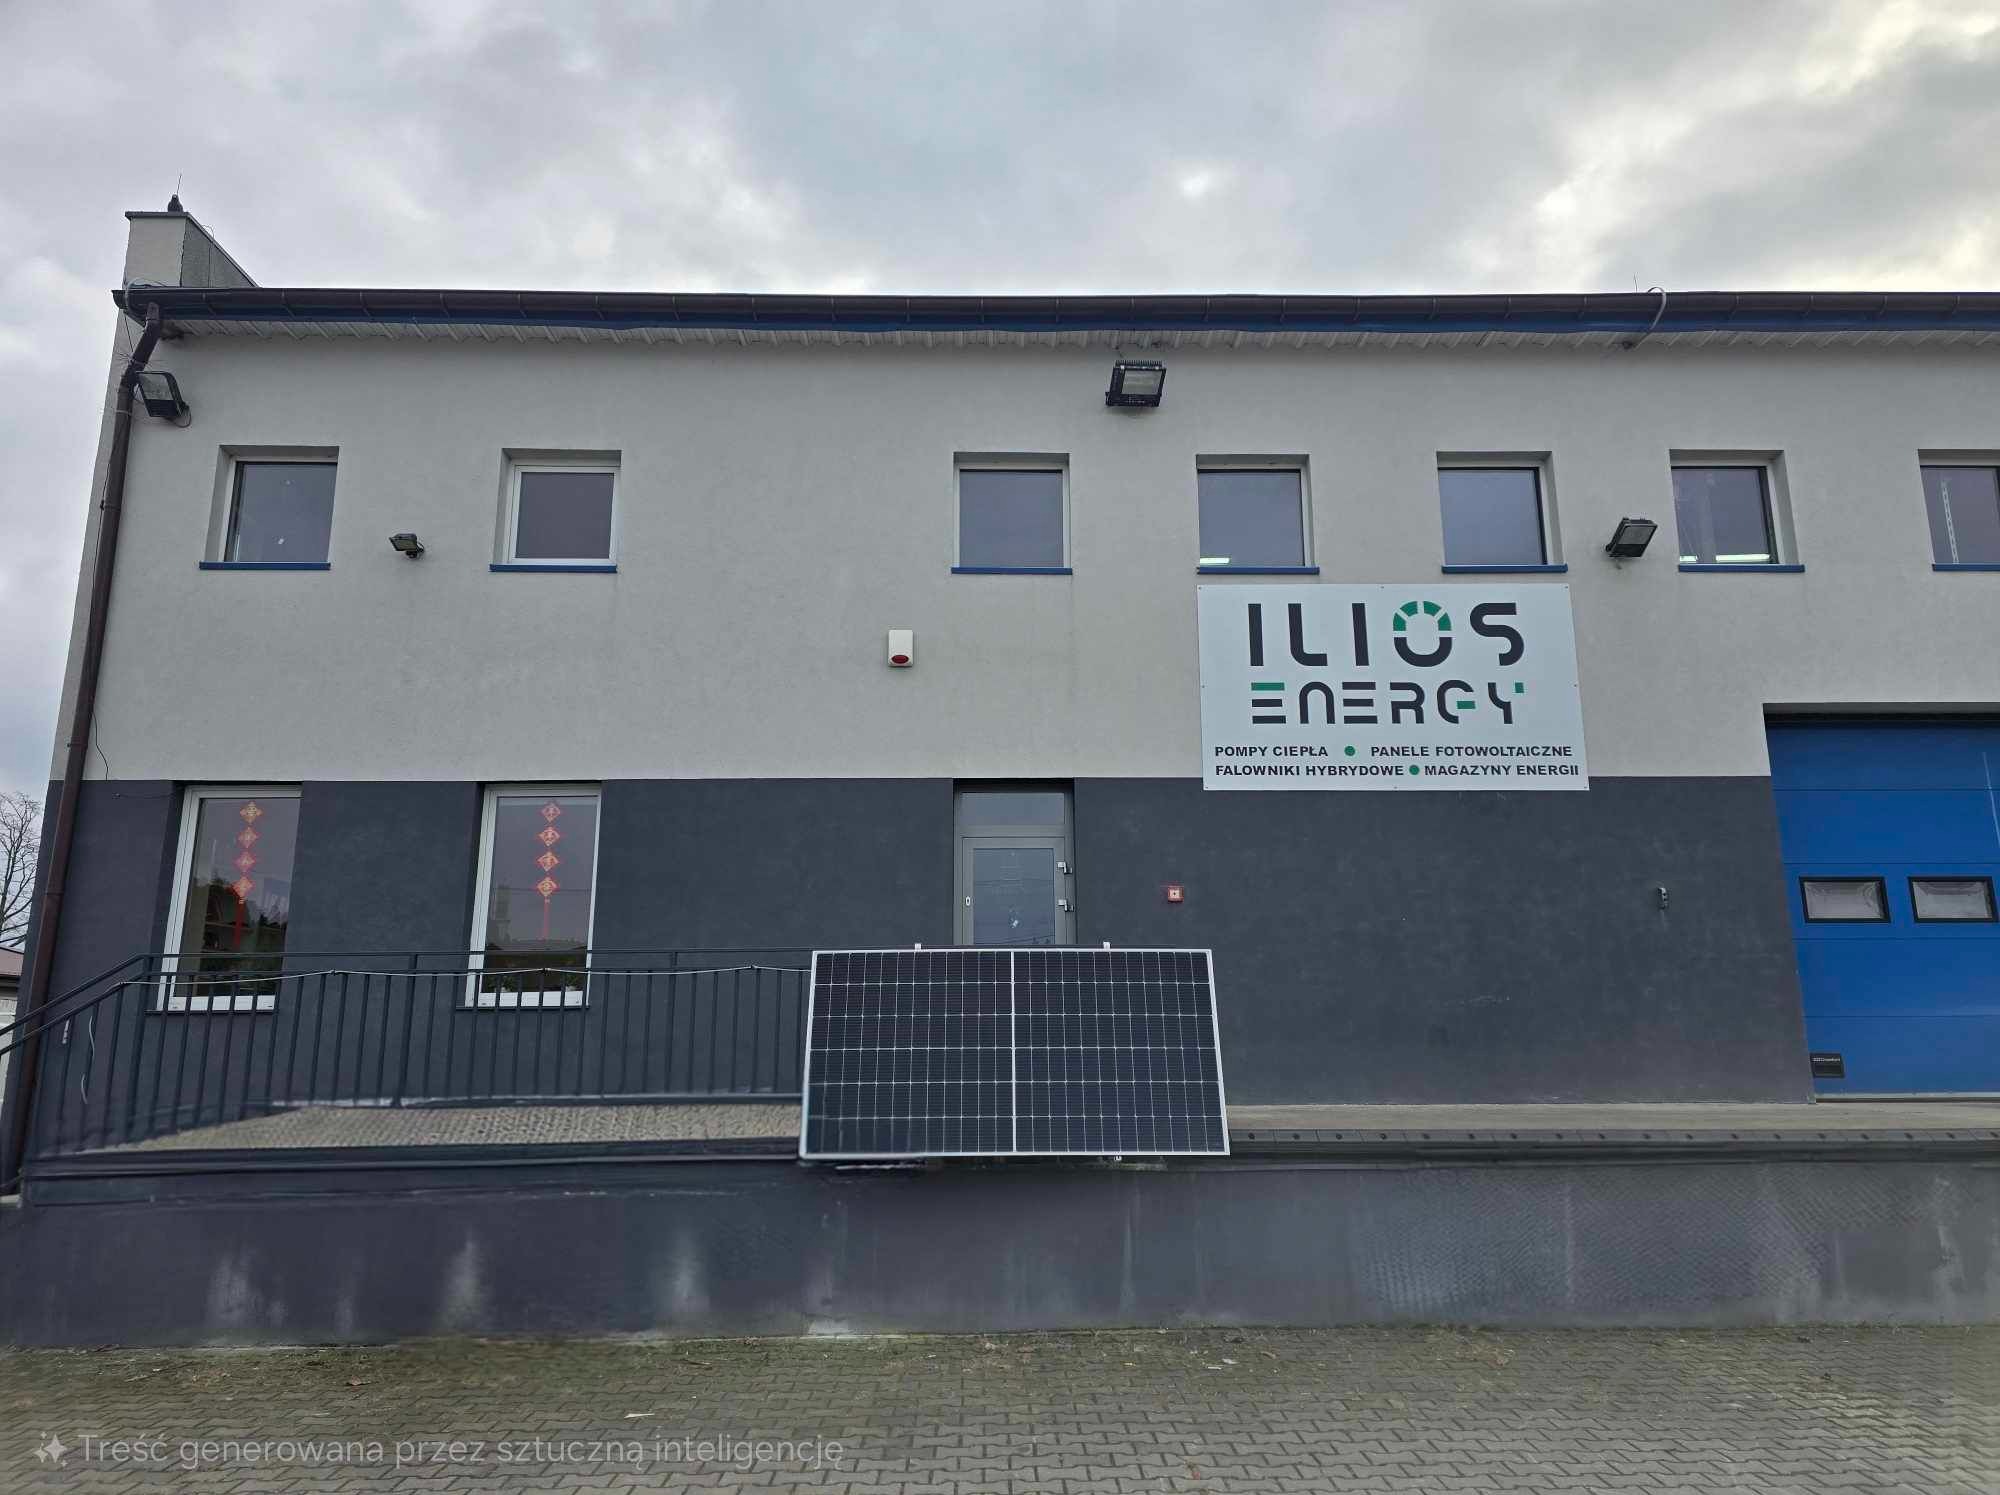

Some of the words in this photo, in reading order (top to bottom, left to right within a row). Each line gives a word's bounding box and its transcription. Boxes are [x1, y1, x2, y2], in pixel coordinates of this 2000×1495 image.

[1247, 600, 1525, 668] ILIOS
[1250, 679, 1525, 725] ENERGY
[1214, 745, 1268, 757] POMPY
[1272, 745, 1329, 757] CIEPŁA
[1370, 745, 1430, 757] PANELE
[1435, 745, 1573, 757] FOTOWOLTAICZNE
[1215, 765, 1300, 776] FALOWNIKI
[1305, 765, 1404, 776] HYBRYDOWE
[1424, 765, 1512, 776] MAGAZYNY
[1516, 765, 1579, 776] ENERGII
